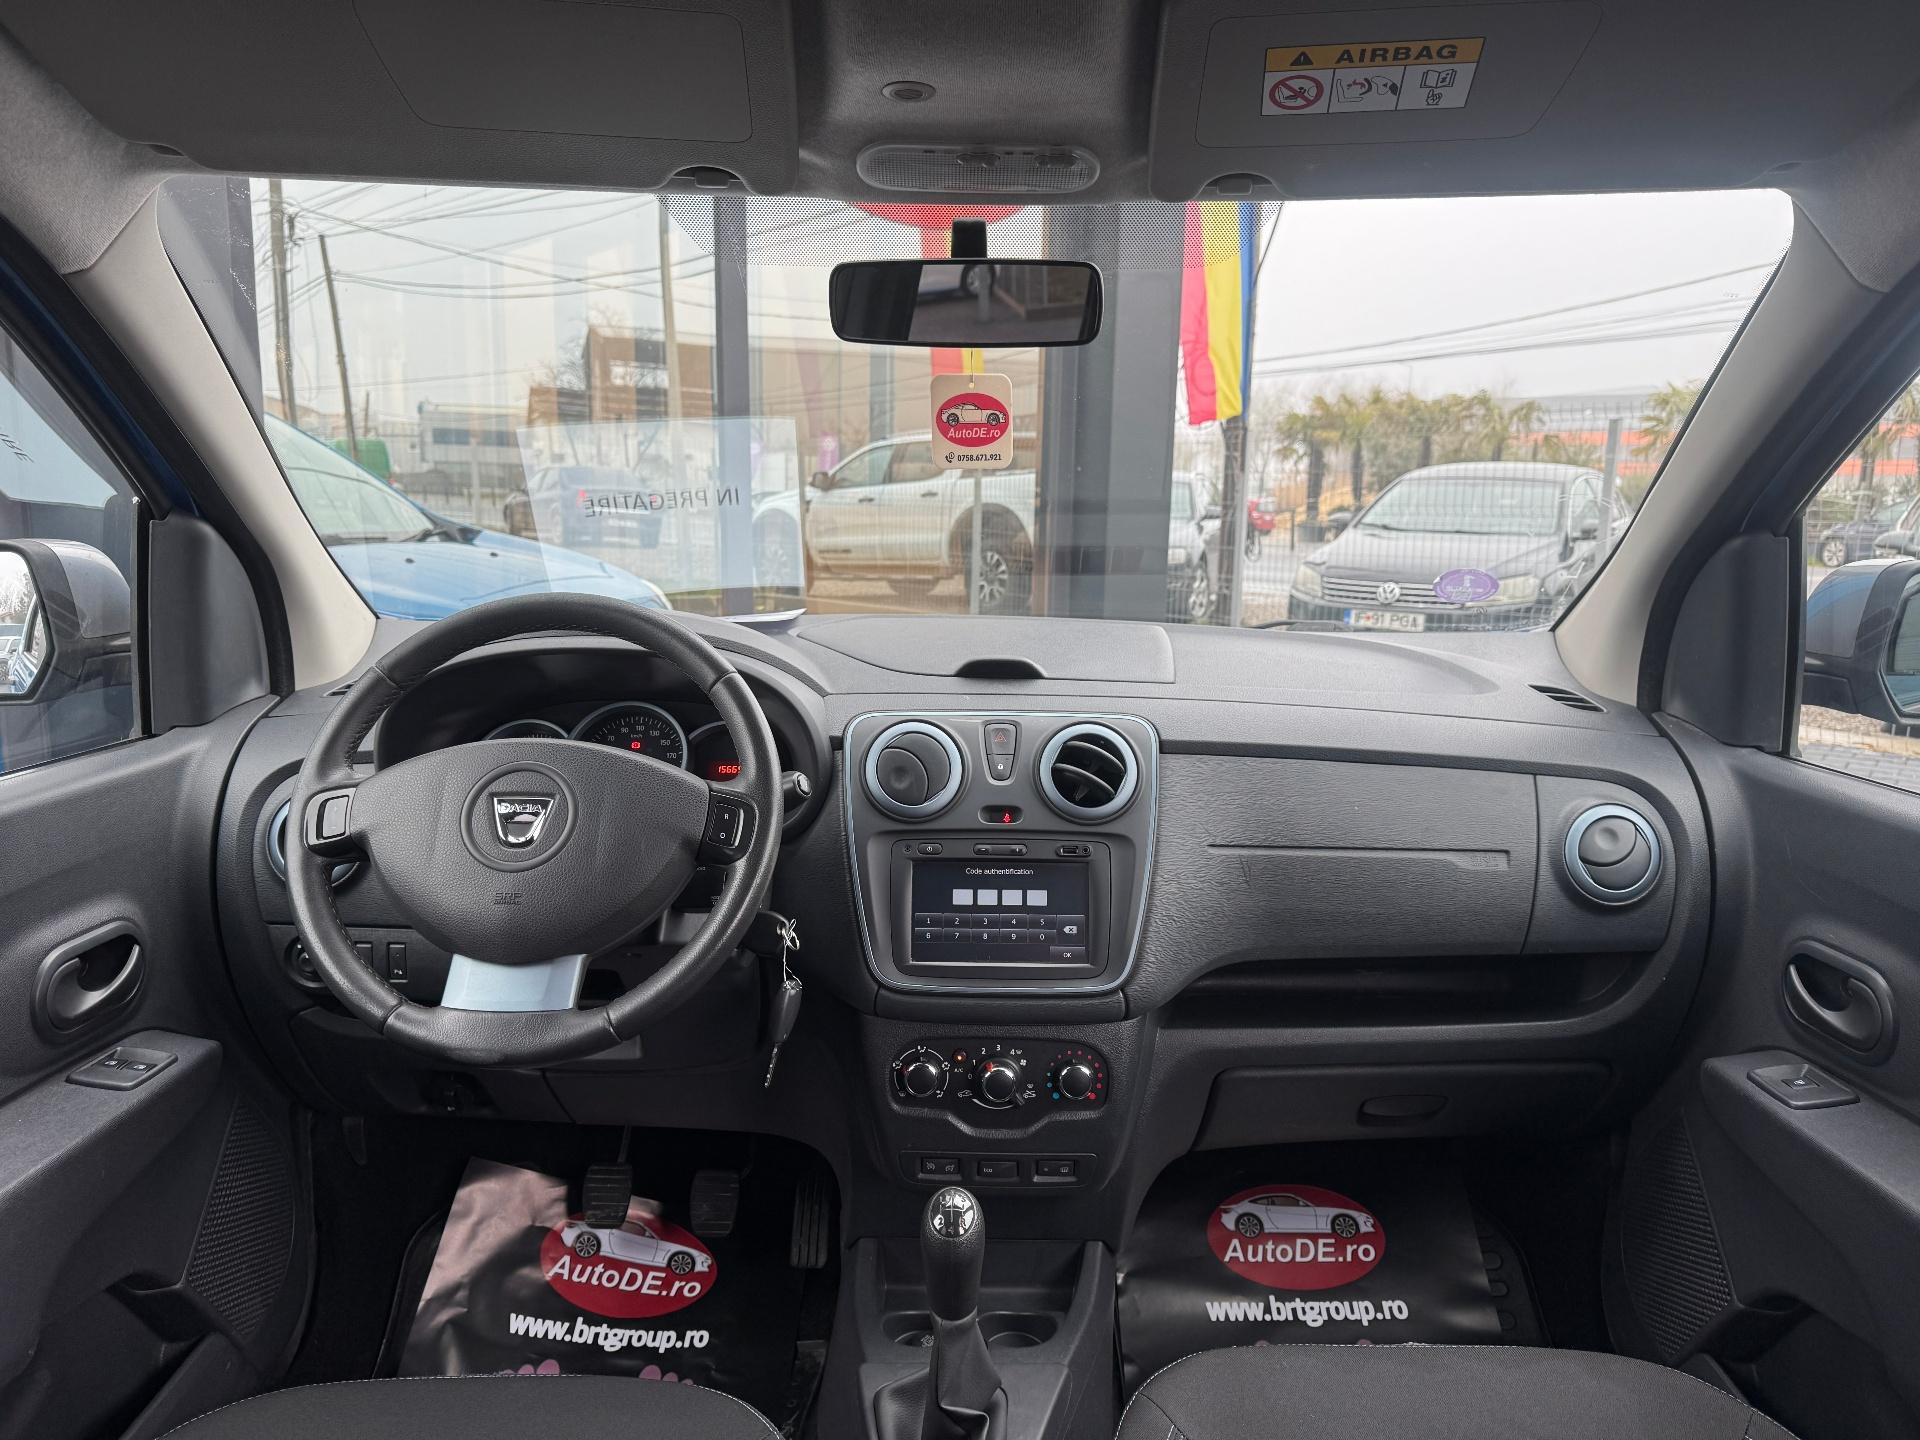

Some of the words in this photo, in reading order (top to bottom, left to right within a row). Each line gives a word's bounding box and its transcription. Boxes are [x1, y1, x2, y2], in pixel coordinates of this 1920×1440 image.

[1335, 44, 1458, 64] AIRBAG
[947, 427, 1001, 439] AutoDE.ro
[957, 453, 1002, 462] 0758.671.921
[1390, 614, 1417, 628] PGA
[497, 802, 543, 814] DACIA
[965, 867, 983, 875] Code
[984, 867, 1034, 875] authentification
[981, 1047, 986, 1055] 2
[938, 1217, 944, 1226] 2
[1223, 1238, 1376, 1264] AutoDE.ro
[548, 1255, 702, 1298] AutoDE.ro
[1205, 1294, 1409, 1328] www.brtgroup.ro
[509, 1312, 710, 1353] www.brtgroup.ro
